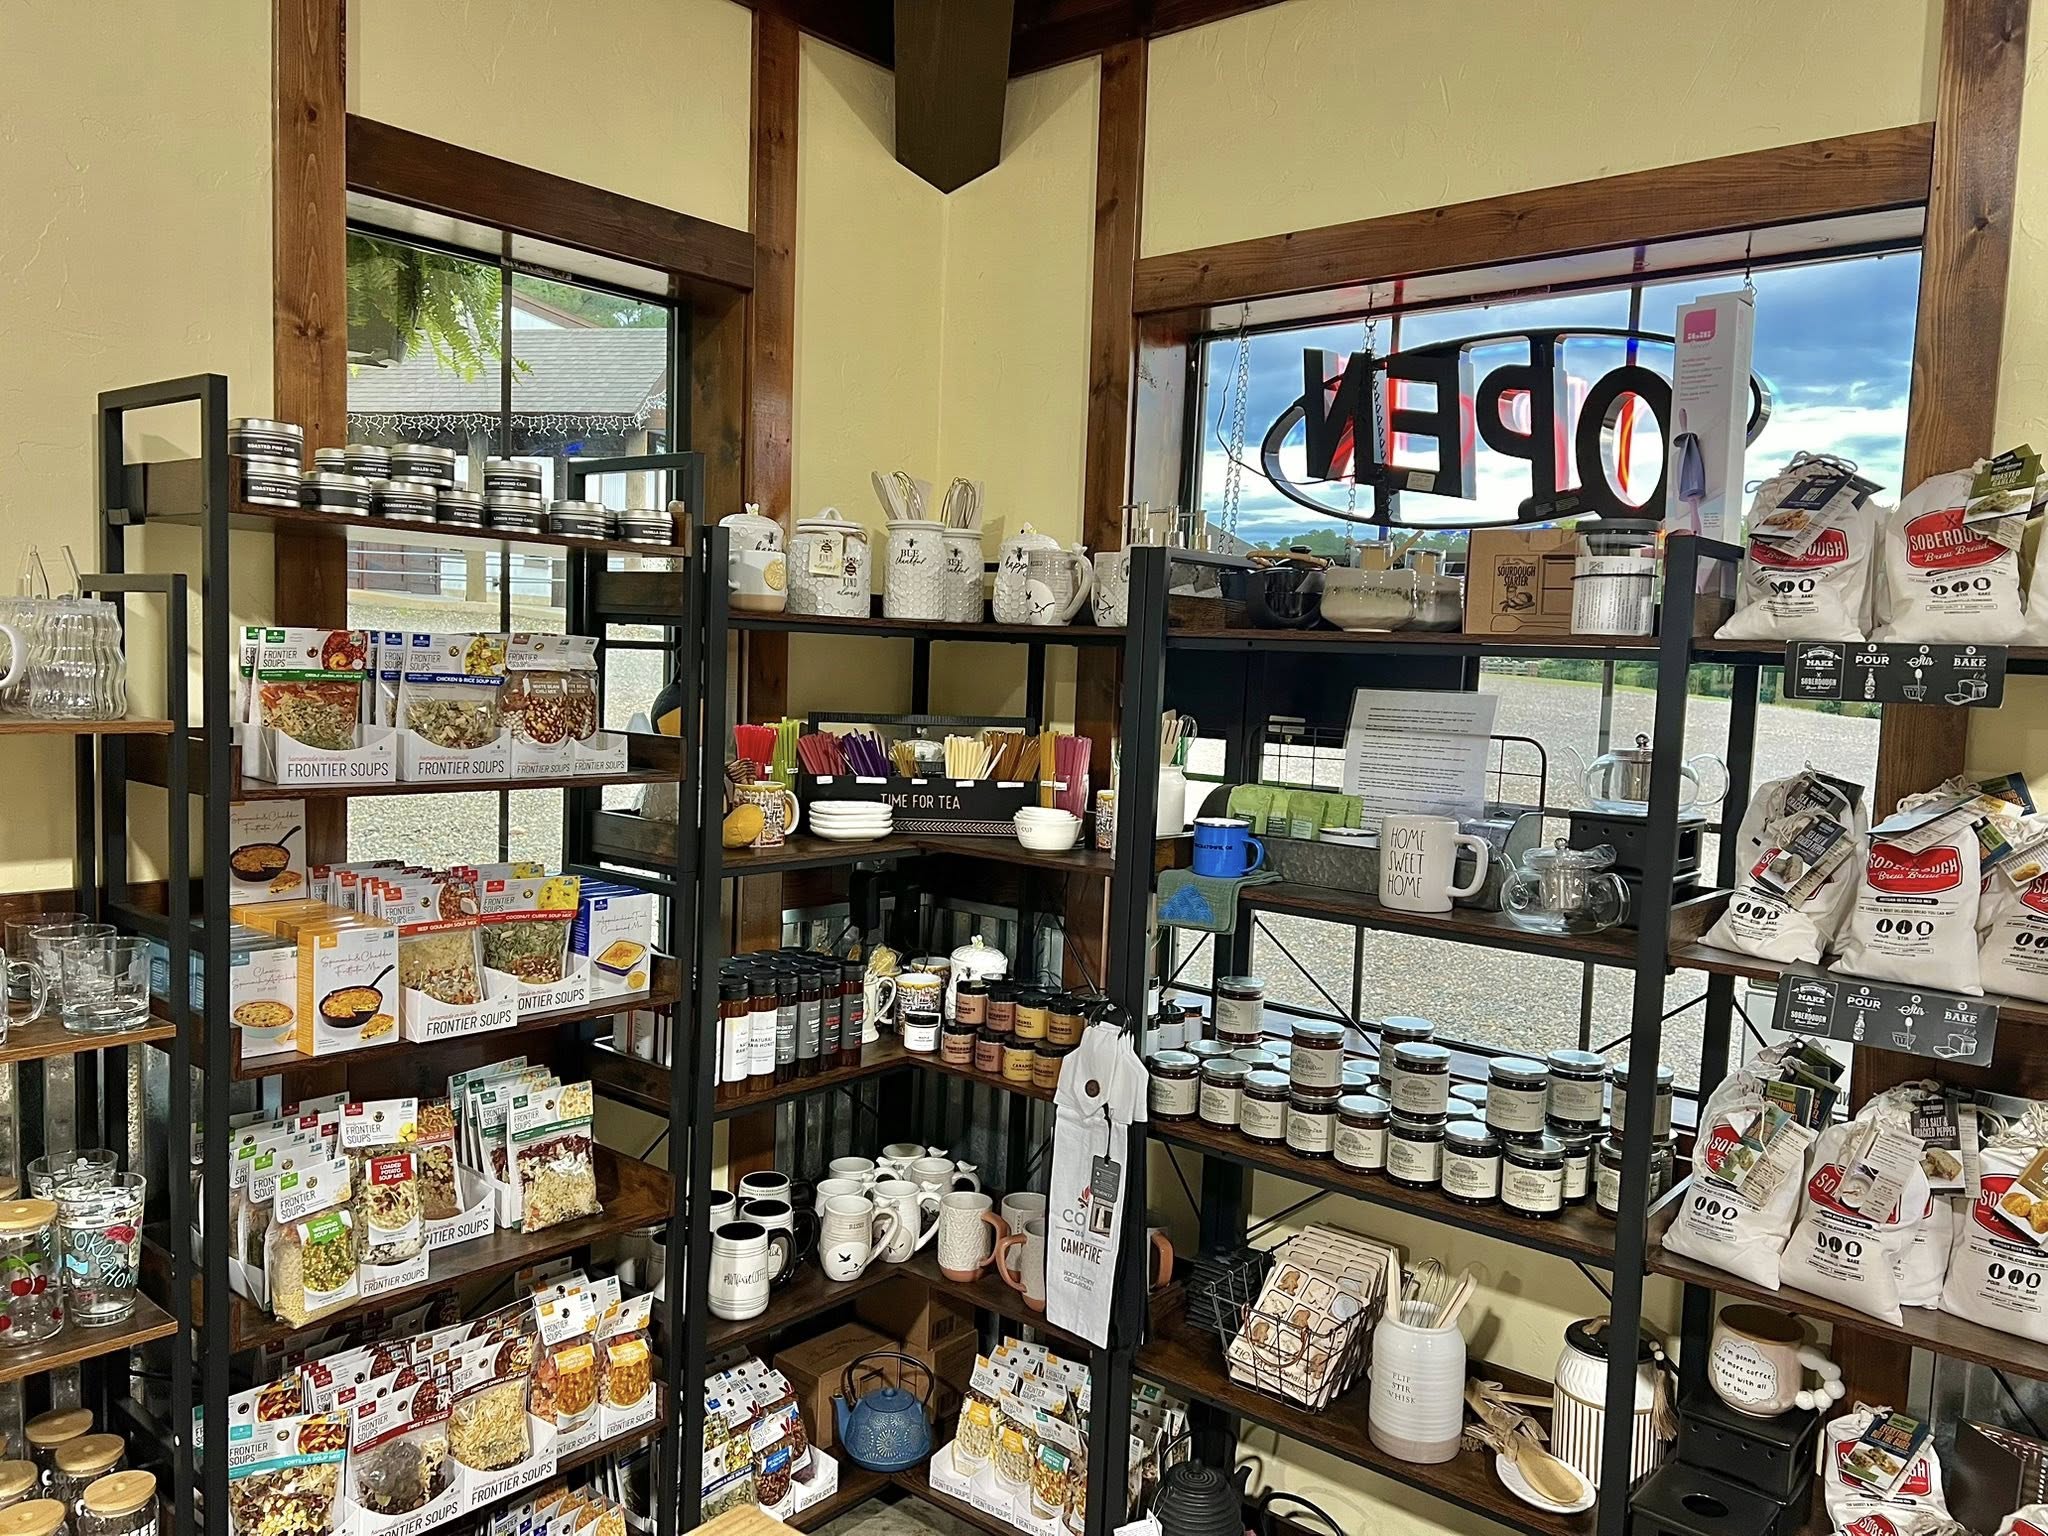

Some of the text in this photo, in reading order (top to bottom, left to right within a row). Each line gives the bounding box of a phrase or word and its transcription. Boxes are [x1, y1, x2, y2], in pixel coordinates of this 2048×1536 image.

[1925, 543, 1989, 562] Brew Bread
[1497, 565, 1536, 577] SOURDOUGH
[1504, 576, 1528, 587] STARTER
[264, 651, 297, 659] FRONTIER
[410, 654, 440, 663] FRONTIER
[509, 653, 537, 661] FRONTIER
[1856, 656, 1889, 665] POUR
[263, 659, 285, 667] SOUPS
[1953, 658, 1987, 667] BAKE
[288, 763, 388, 777] FRONTIER SOUPS
[418, 761, 504, 776] FRONTIER SOUPS
[517, 763, 570, 774] FRONTIER SOUPS
[574, 760, 625, 770] FRONTIER SOUPS
[880, 794, 960, 809] TIME FOR TEA
[1390, 827, 1426, 851] HOME
[1388, 851, 1424, 874] SWEET
[1388, 874, 1423, 898] HOME
[484, 897, 515, 906] FRONTIER
[385, 907, 415, 915] FRONTIER
[555, 989, 584, 1005] SOUPS
[1797, 994, 1825, 1003] MAKE
[1847, 996, 1881, 1009] POUR
[426, 1010, 511, 1036] FRONTIER SOUPS
[1944, 1011, 1978, 1024] BAKE
[515, 1111, 539, 1122] FRONTIER
[1919, 1117, 1942, 1128] SEA SALT
[346, 1123, 382, 1135] FRONTIER
[515, 1121, 531, 1130] SOUPS
[1913, 1125, 1956, 1138] CRACKED PEPPER
[347, 1134, 371, 1144] SOUPS
[380, 1162, 402, 1170] LOADED
[280, 1190, 316, 1209] FRONTIER
[281, 1206, 305, 1219] SOUPS
[312, 1222, 338, 1233] WEDDING
[457, 1219, 489, 1237] SOUPS
[314, 1230, 327, 1239] SOUP
[1061, 1237, 1103, 1265] CAMPFIRE
[363, 1269, 425, 1293] FRONTIER SOUPS
[545, 1320, 568, 1332] FRONTIER
[546, 1330, 562, 1342] SOUPS
[1736, 1354, 1756, 1364] gonna
[1728, 1361, 1743, 1371] more
[1747, 1369, 1771, 1379] coffee
[489, 1378, 504, 1386] ONION
[974, 1371, 993, 1386] FRONTIER
[1722, 1369, 1735, 1378] deal
[1737, 1377, 1754, 1386] with
[972, 1379, 985, 1389] SOUPS
[1392, 1382, 1411, 1393] STIR
[1022, 1392, 1036, 1401] SOUPS
[1024, 1384, 1046, 1397] FRONTIER
[1734, 1387, 1747, 1395] this
[357, 1415, 388, 1434] FRONTIER
[606, 1410, 653, 1435] FRONTIER SOUPS
[357, 1428, 378, 1442] SOUPS
[577, 1432, 596, 1447] SOUPS
[229, 1443, 268, 1457] FRONTIER
[229, 1454, 256, 1466] SOUPS
[283, 1455, 328, 1465] TORTILLA SOUP
[472, 1461, 552, 1505] FRONTIER SOUPS
[932, 1478, 969, 1498] FRONTIER SOUPS
[800, 1484, 836, 1509] FRONTIER SOUPS
[425, 1502, 458, 1526] SOUPS
[973, 1497, 1012, 1521] FRONTIER SOUPS
